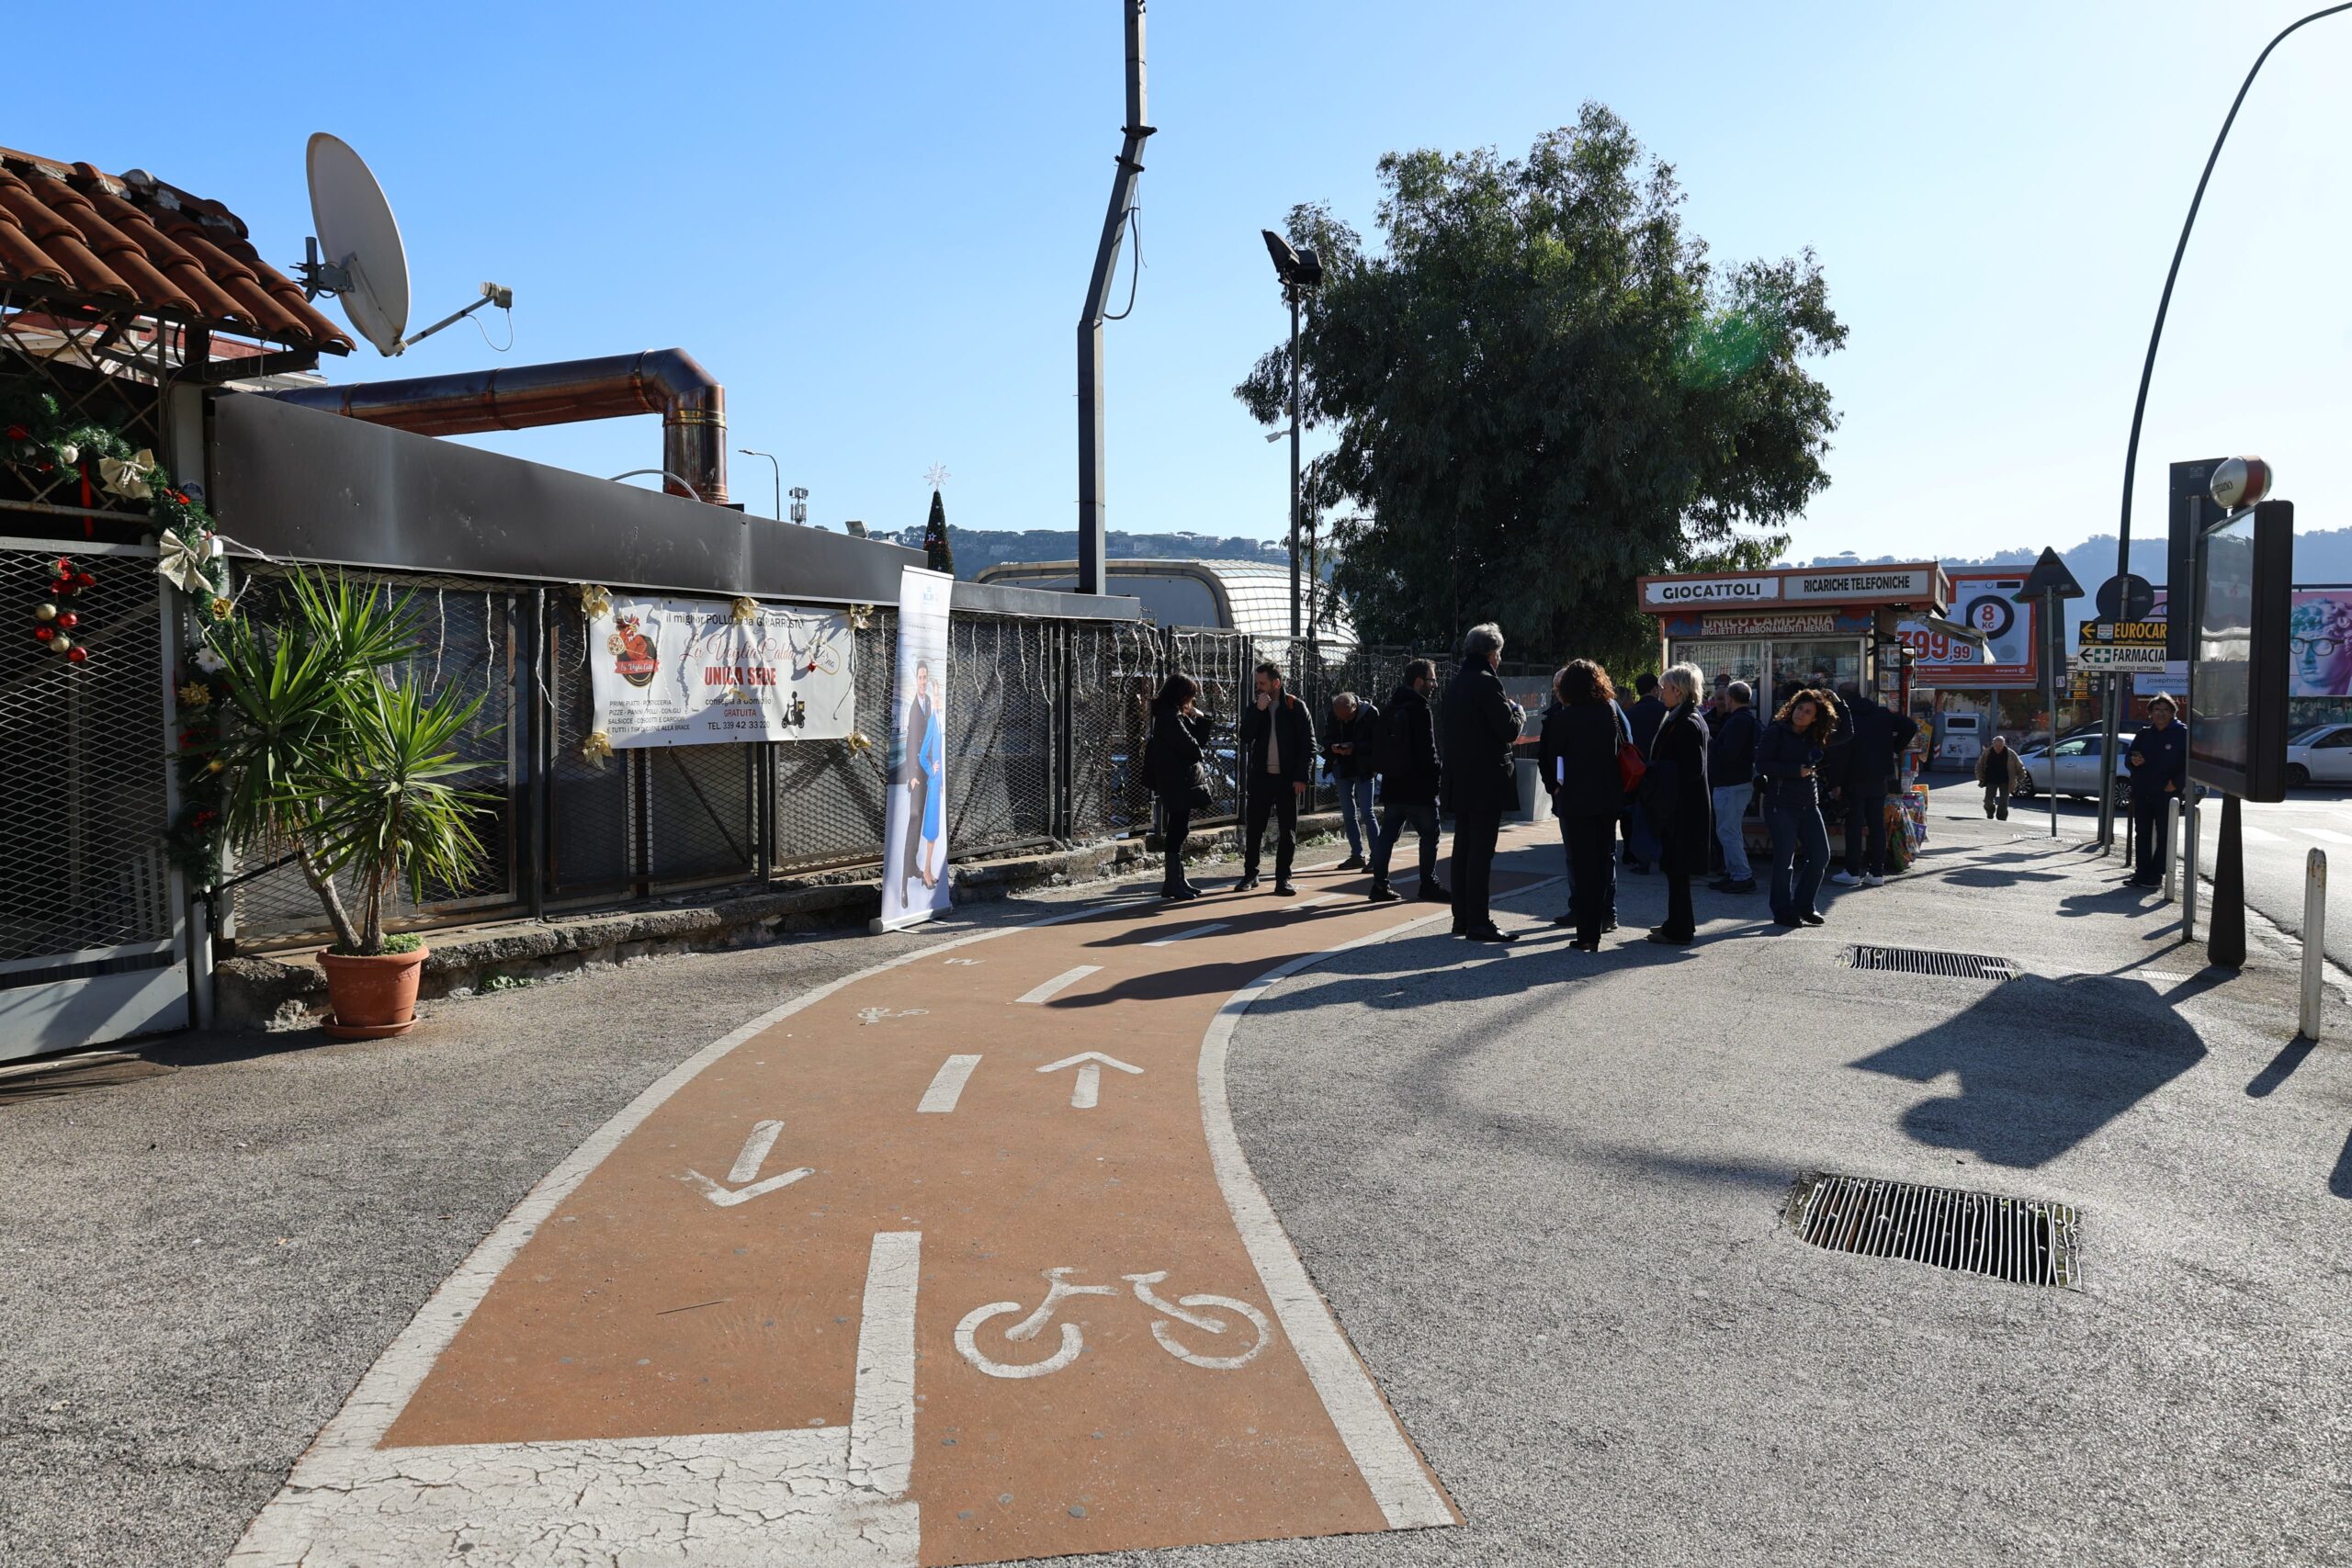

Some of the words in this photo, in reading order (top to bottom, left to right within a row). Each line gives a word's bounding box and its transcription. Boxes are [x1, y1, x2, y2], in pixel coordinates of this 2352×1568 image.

[1804, 577, 1849, 592] RICARICHE
[1850, 575, 1910, 592] TELEFONICHE
[1662, 582, 1761, 600] GIOCATTOLI
[1982, 604, 1995, 621] 8
[673, 615, 704, 626] miglior
[706, 614, 733, 625] POLLO
[1702, 617, 1749, 628] UNICO
[1753, 615, 1835, 626] CAMPANIA
[1982, 621, 1995, 629] KG
[1701, 626, 1736, 636] BIGLIETTI
[1744, 625, 1802, 634] ABBONAMENTI
[1803, 624, 1834, 633] MENSILI
[2113, 622, 2167, 639] EUROCAR
[2113, 648, 2165, 662] FARMACIA
[705, 666, 743, 686] UNICA
[747, 667, 777, 686] SEDE
[723, 709, 757, 717] GRATUITA
[722, 721, 734, 729] 339
[735, 721, 747, 729] 42
[749, 721, 758, 729] 33
